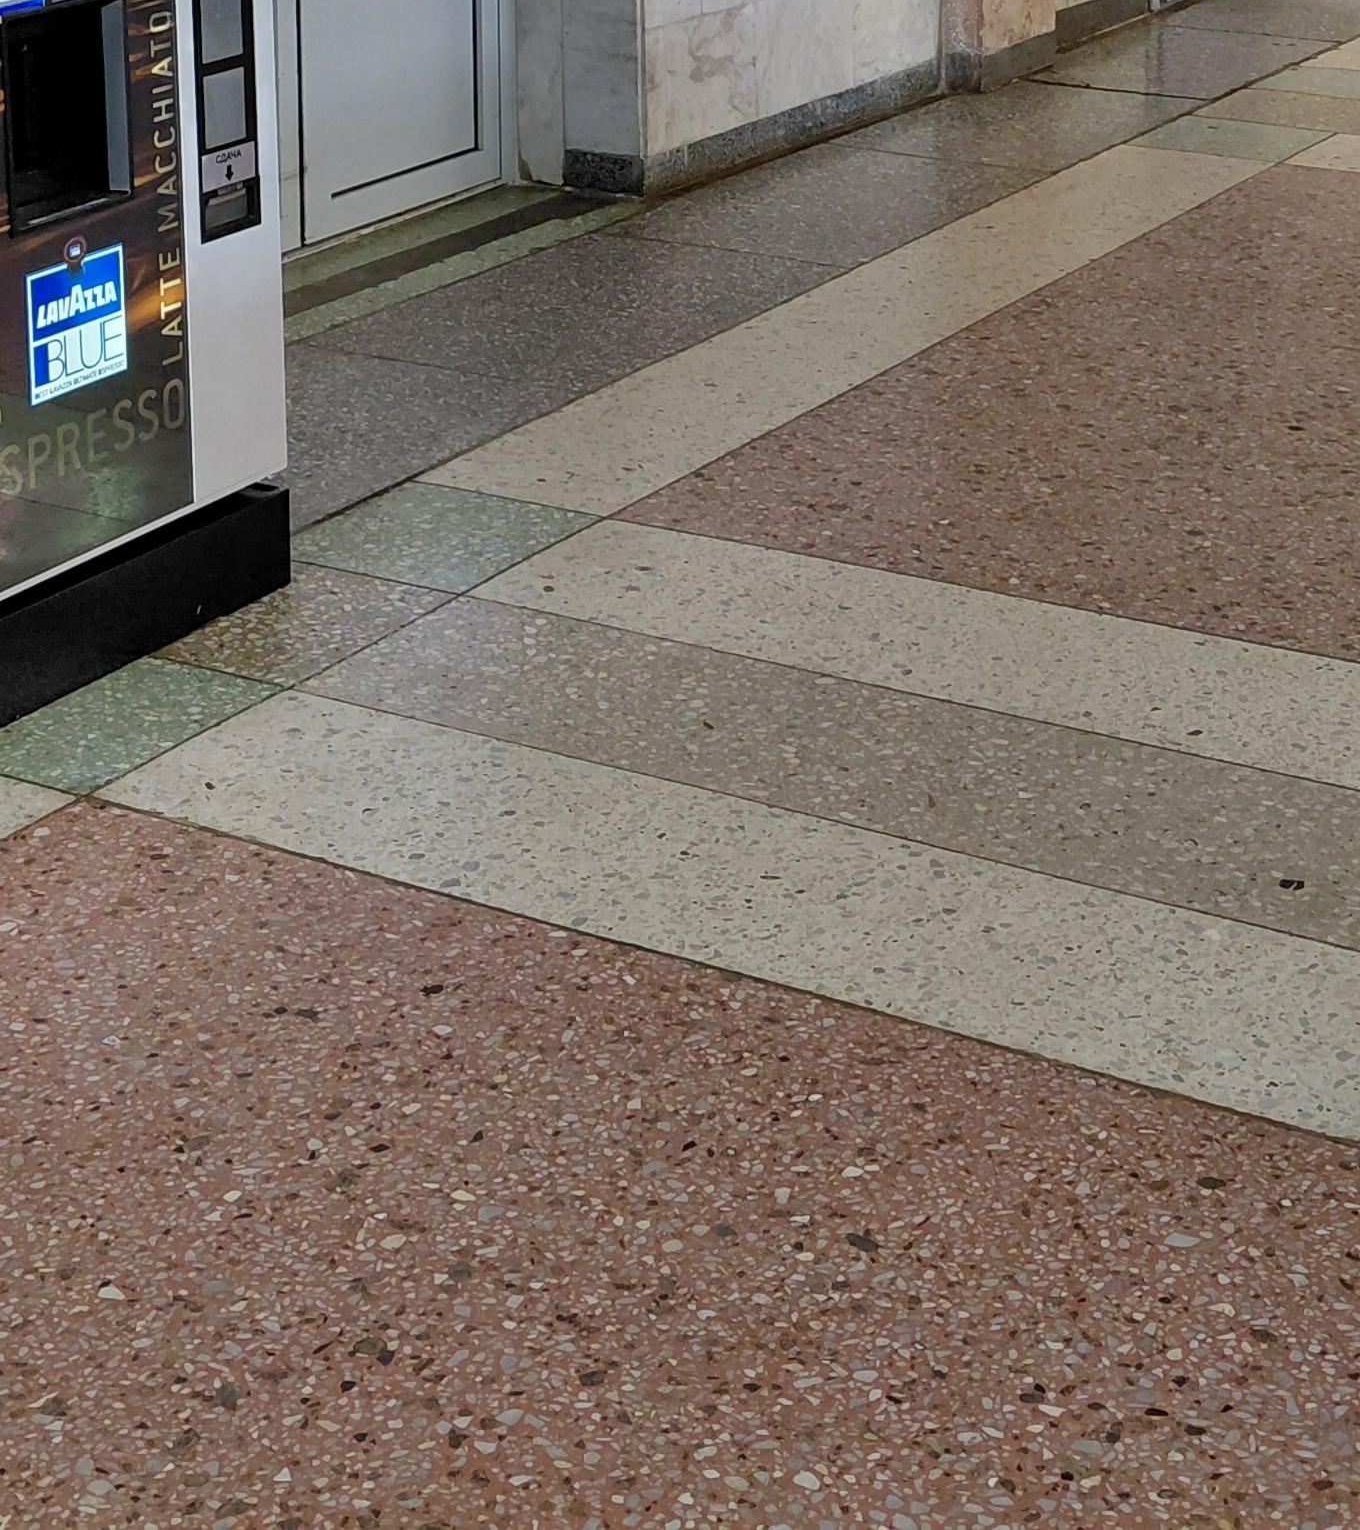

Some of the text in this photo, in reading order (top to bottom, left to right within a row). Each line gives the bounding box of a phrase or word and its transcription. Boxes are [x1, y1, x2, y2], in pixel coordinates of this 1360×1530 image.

[215, 148, 242, 165] СДАЧА
[148, 10, 185, 368] LATTE MACCHIATO
[36, 280, 118, 329] LAVAZZA
[35, 314, 124, 388] BLUE
[34, 359, 125, 400] BEST LAVAZZA ULTIMATE ESPRESSO
